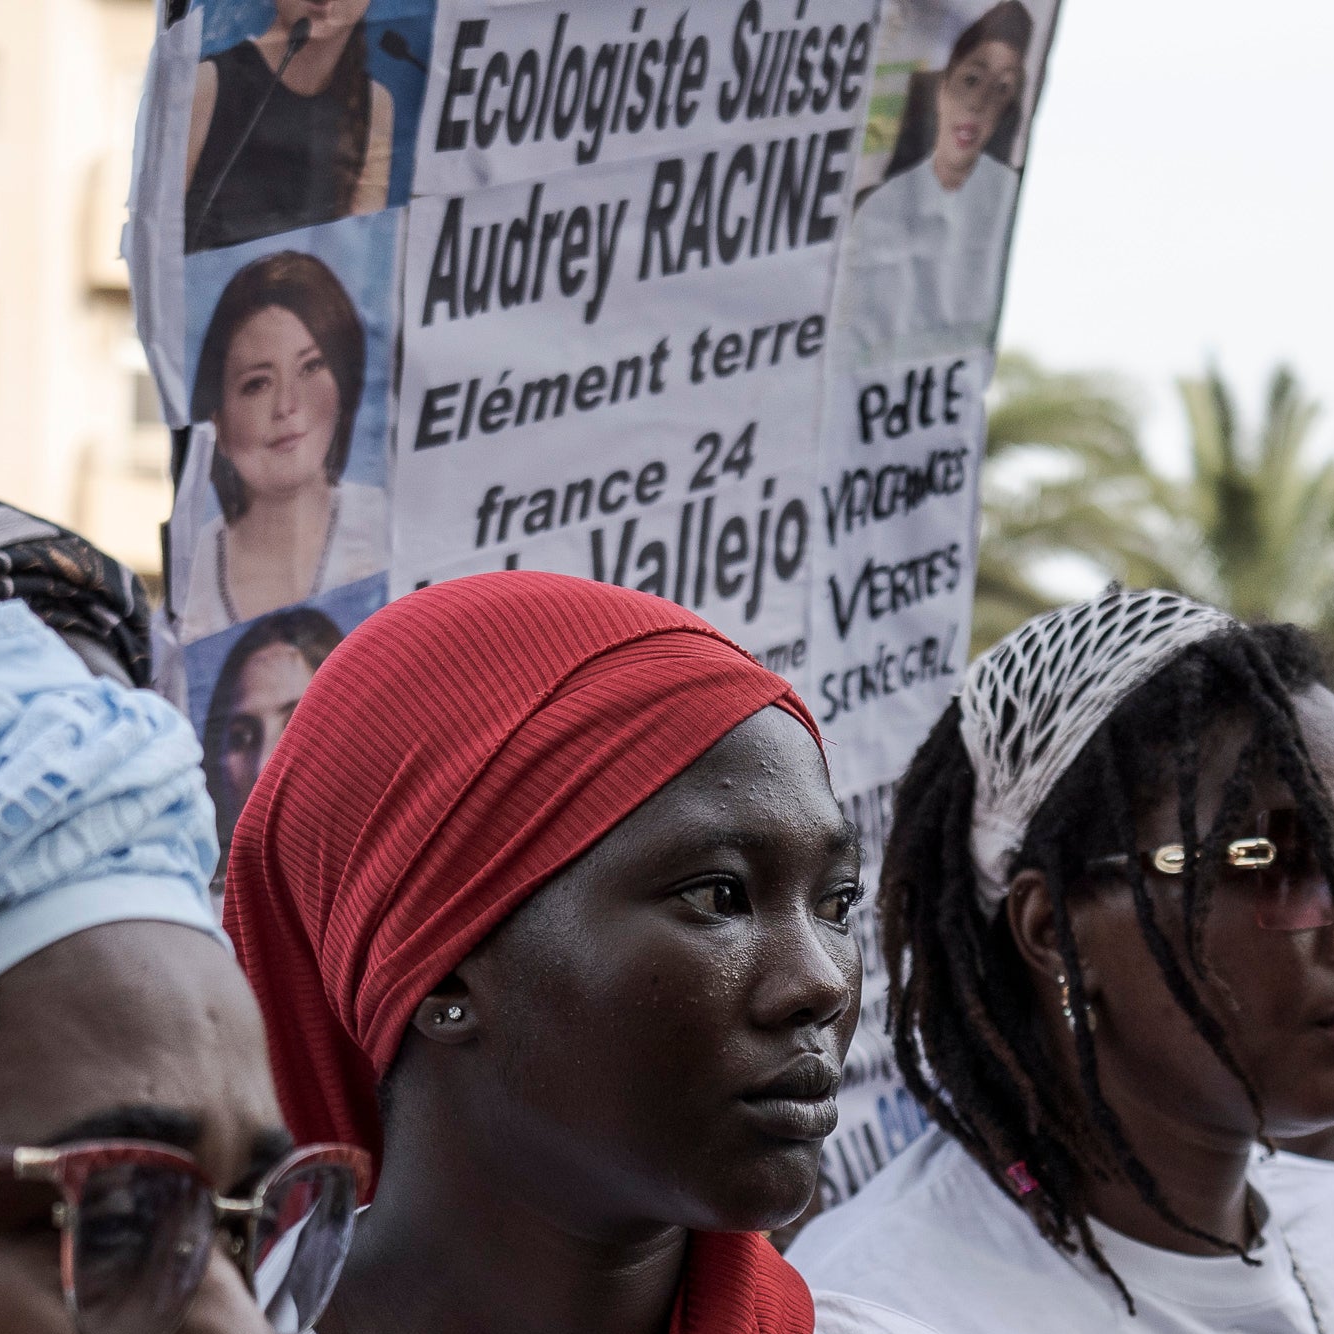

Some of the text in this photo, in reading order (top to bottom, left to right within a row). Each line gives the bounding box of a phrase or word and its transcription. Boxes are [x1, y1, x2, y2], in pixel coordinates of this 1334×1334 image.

[435, 0, 868, 166] Ecologiste Suisse
[422, 127, 854, 324] Audrey RACINE
[413, 314, 825, 452] Elément terre
[476, 420, 757, 548] france 24
[590, 478, 809, 623] Vallejo
